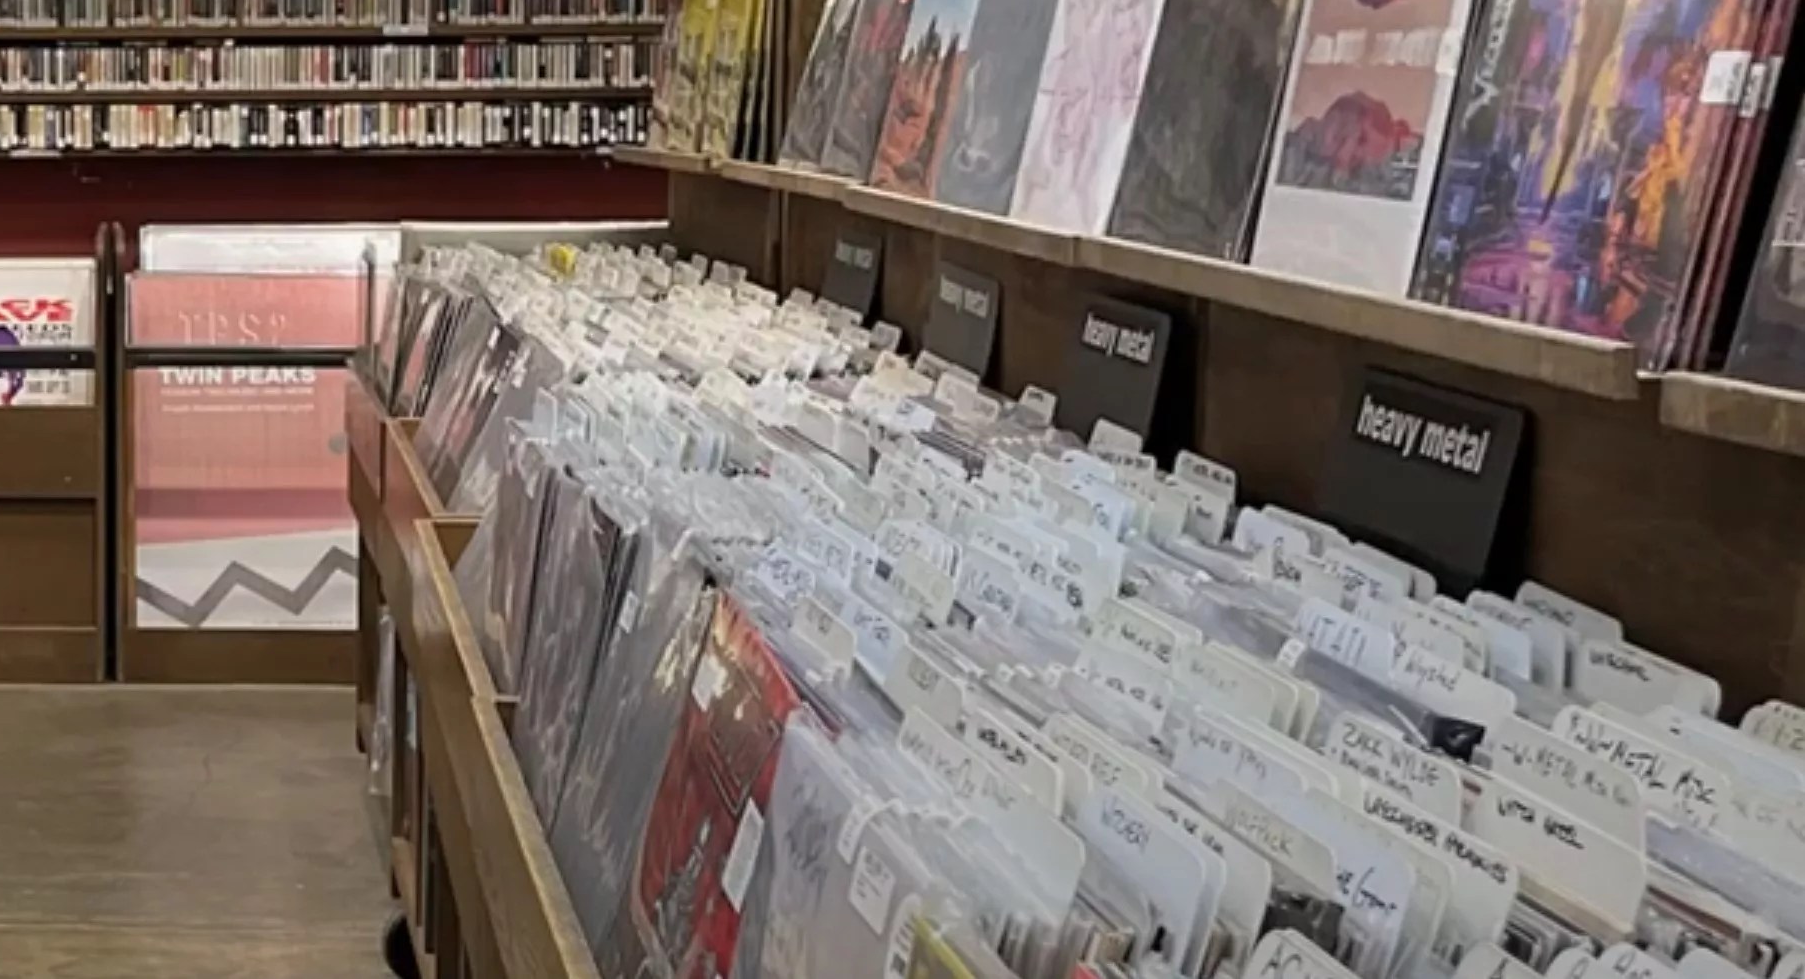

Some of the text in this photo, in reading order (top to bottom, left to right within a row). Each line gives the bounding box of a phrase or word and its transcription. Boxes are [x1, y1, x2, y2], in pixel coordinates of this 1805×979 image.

[1081, 312, 1156, 365] heavy metal
[158, 366, 317, 385] TWIN PEAKS
[1356, 393, 1492, 474] heavy metal
